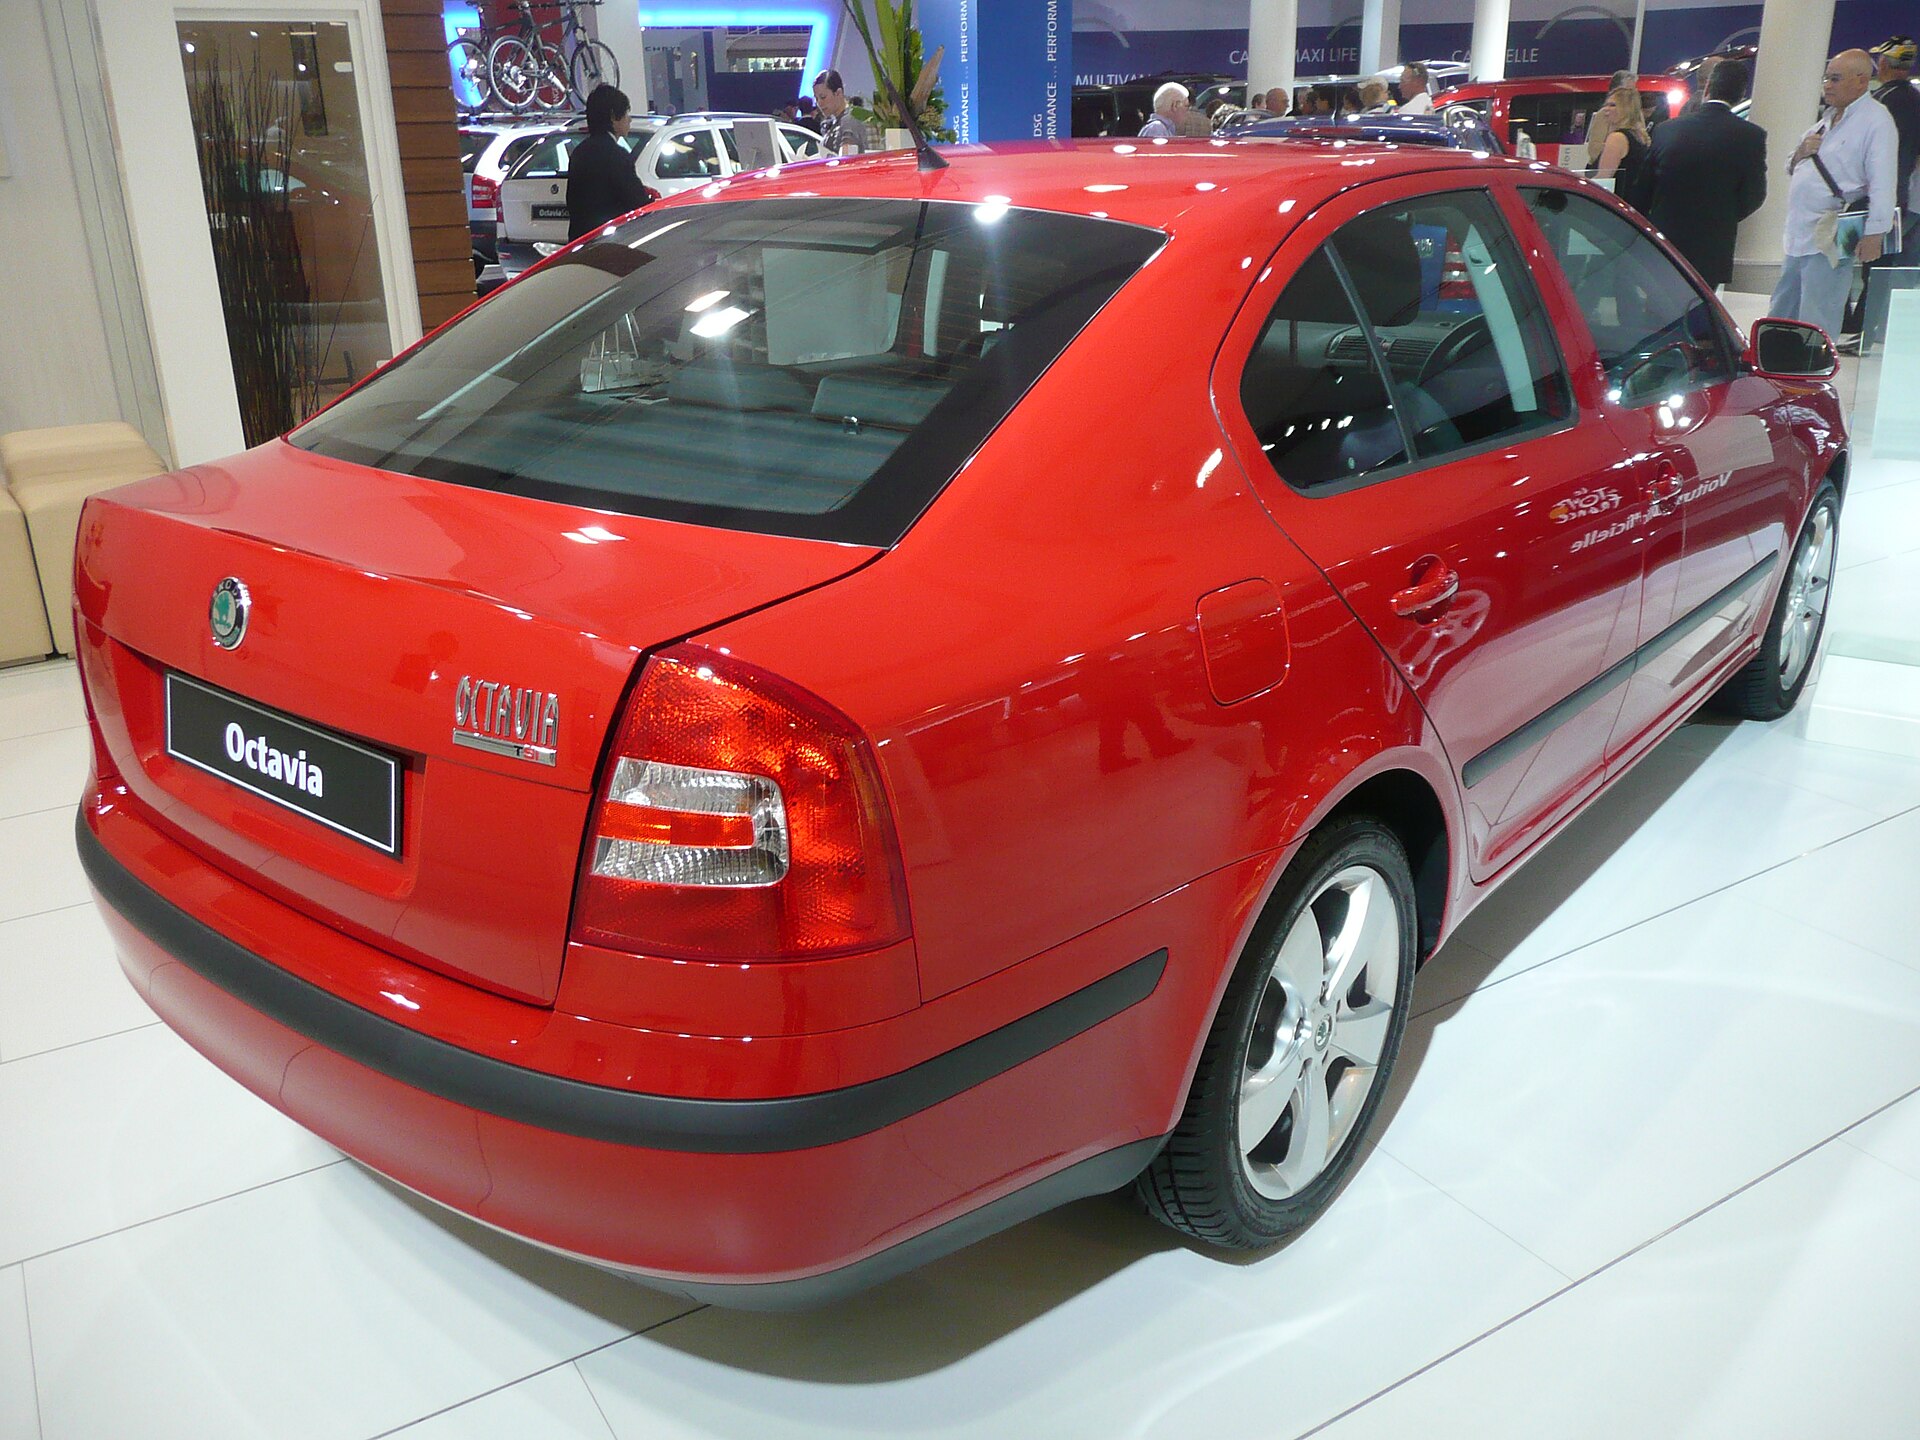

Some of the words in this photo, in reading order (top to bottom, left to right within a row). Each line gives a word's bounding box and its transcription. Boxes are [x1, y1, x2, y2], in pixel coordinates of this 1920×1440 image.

[1329, 47, 1358, 62] LIFE
[1034, 113, 1043, 138] DSG
[455, 675, 559, 747] OCTAVIA
[225, 722, 323, 798] Octavia
[513, 745, 540, 761] TSI
